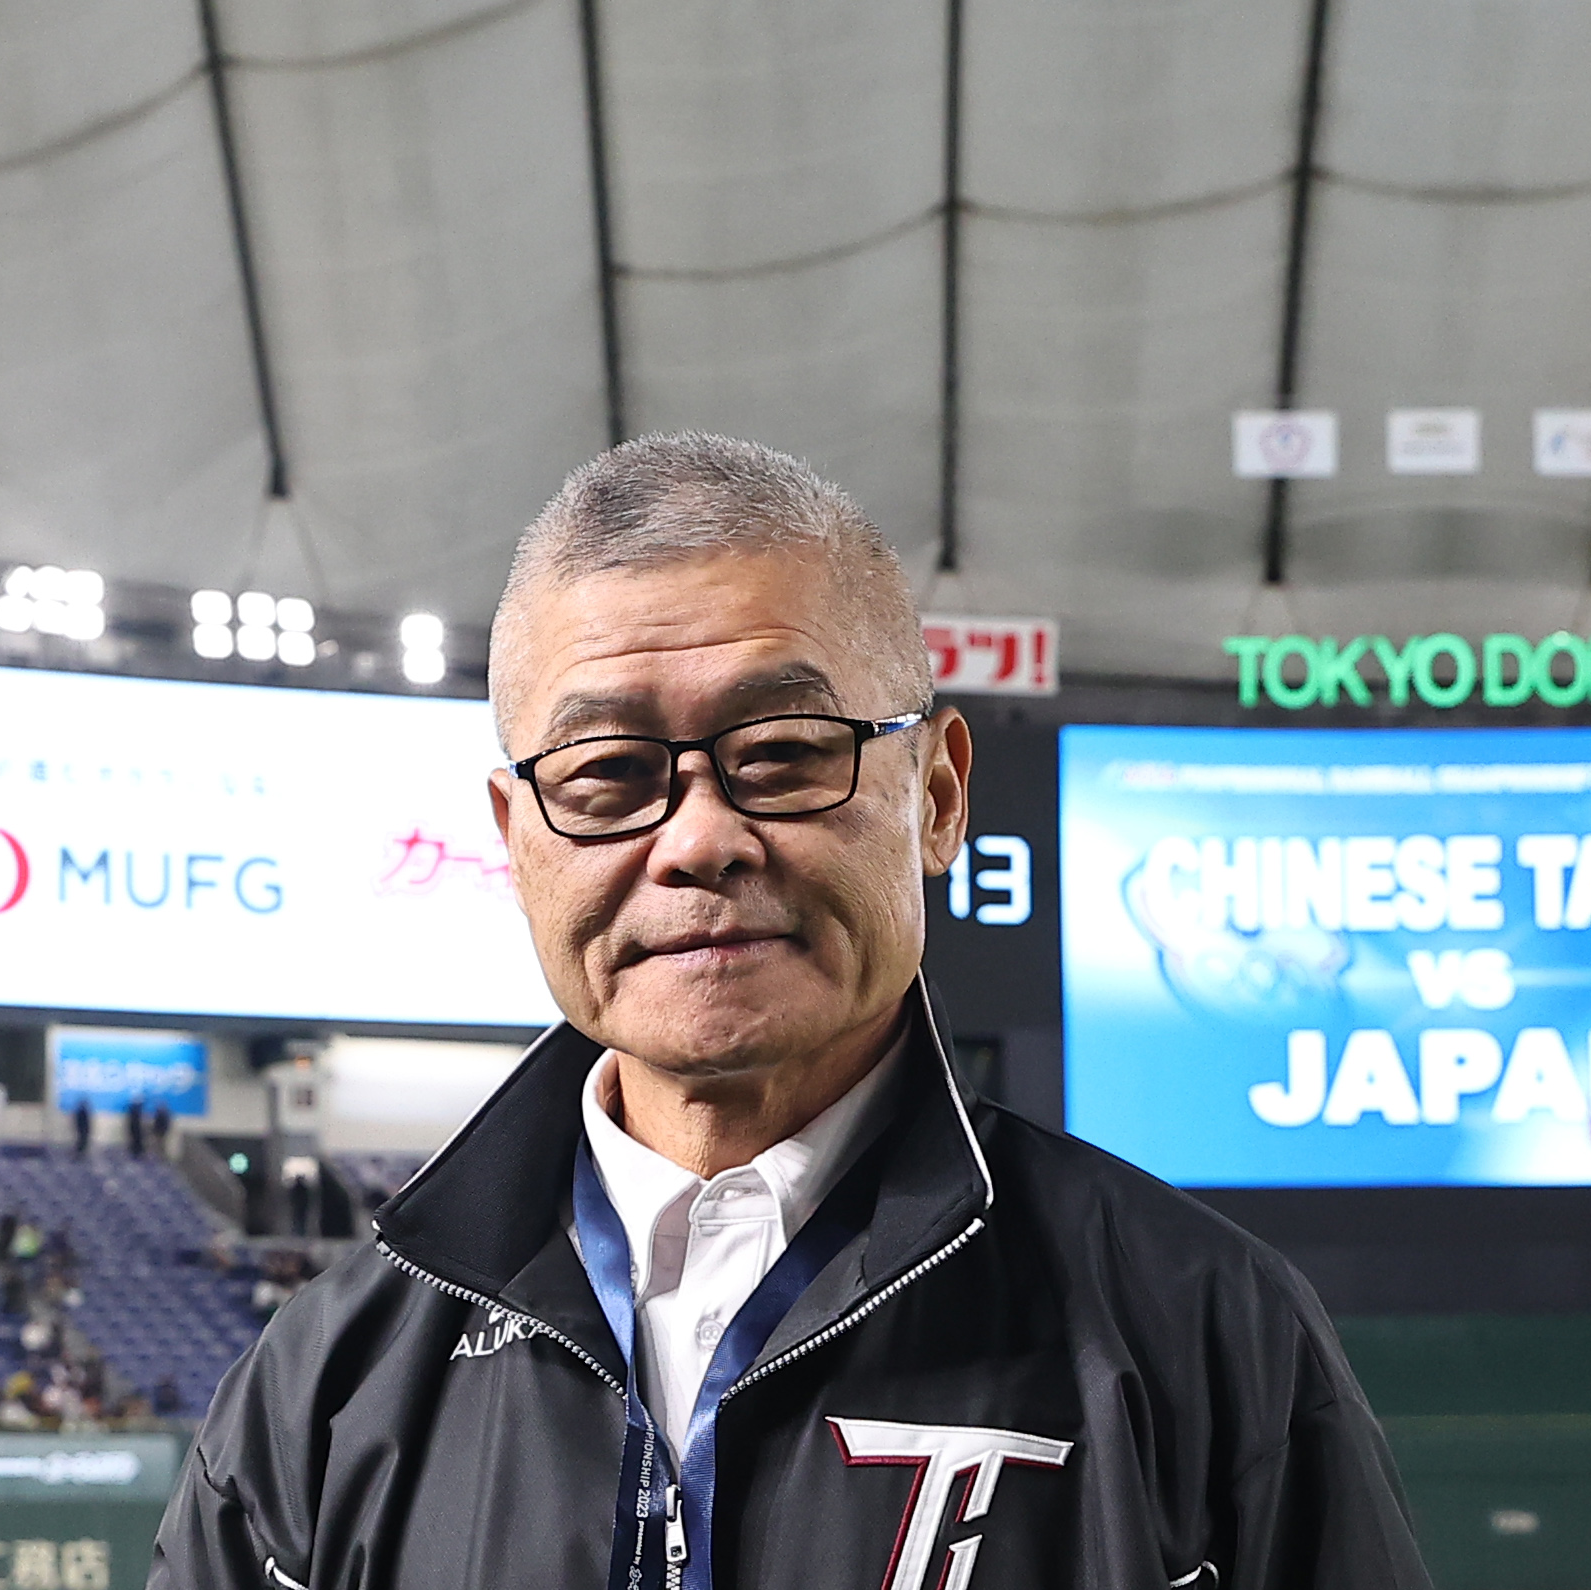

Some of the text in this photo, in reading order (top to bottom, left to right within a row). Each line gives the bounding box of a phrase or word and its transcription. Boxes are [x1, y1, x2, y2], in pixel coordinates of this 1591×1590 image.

[1223, 633, 1477, 710] TOKYO
[57, 846, 284, 915] MUFG
[1142, 832, 1505, 934] CHINESE
[635, 1488, 651, 1519] 2023
